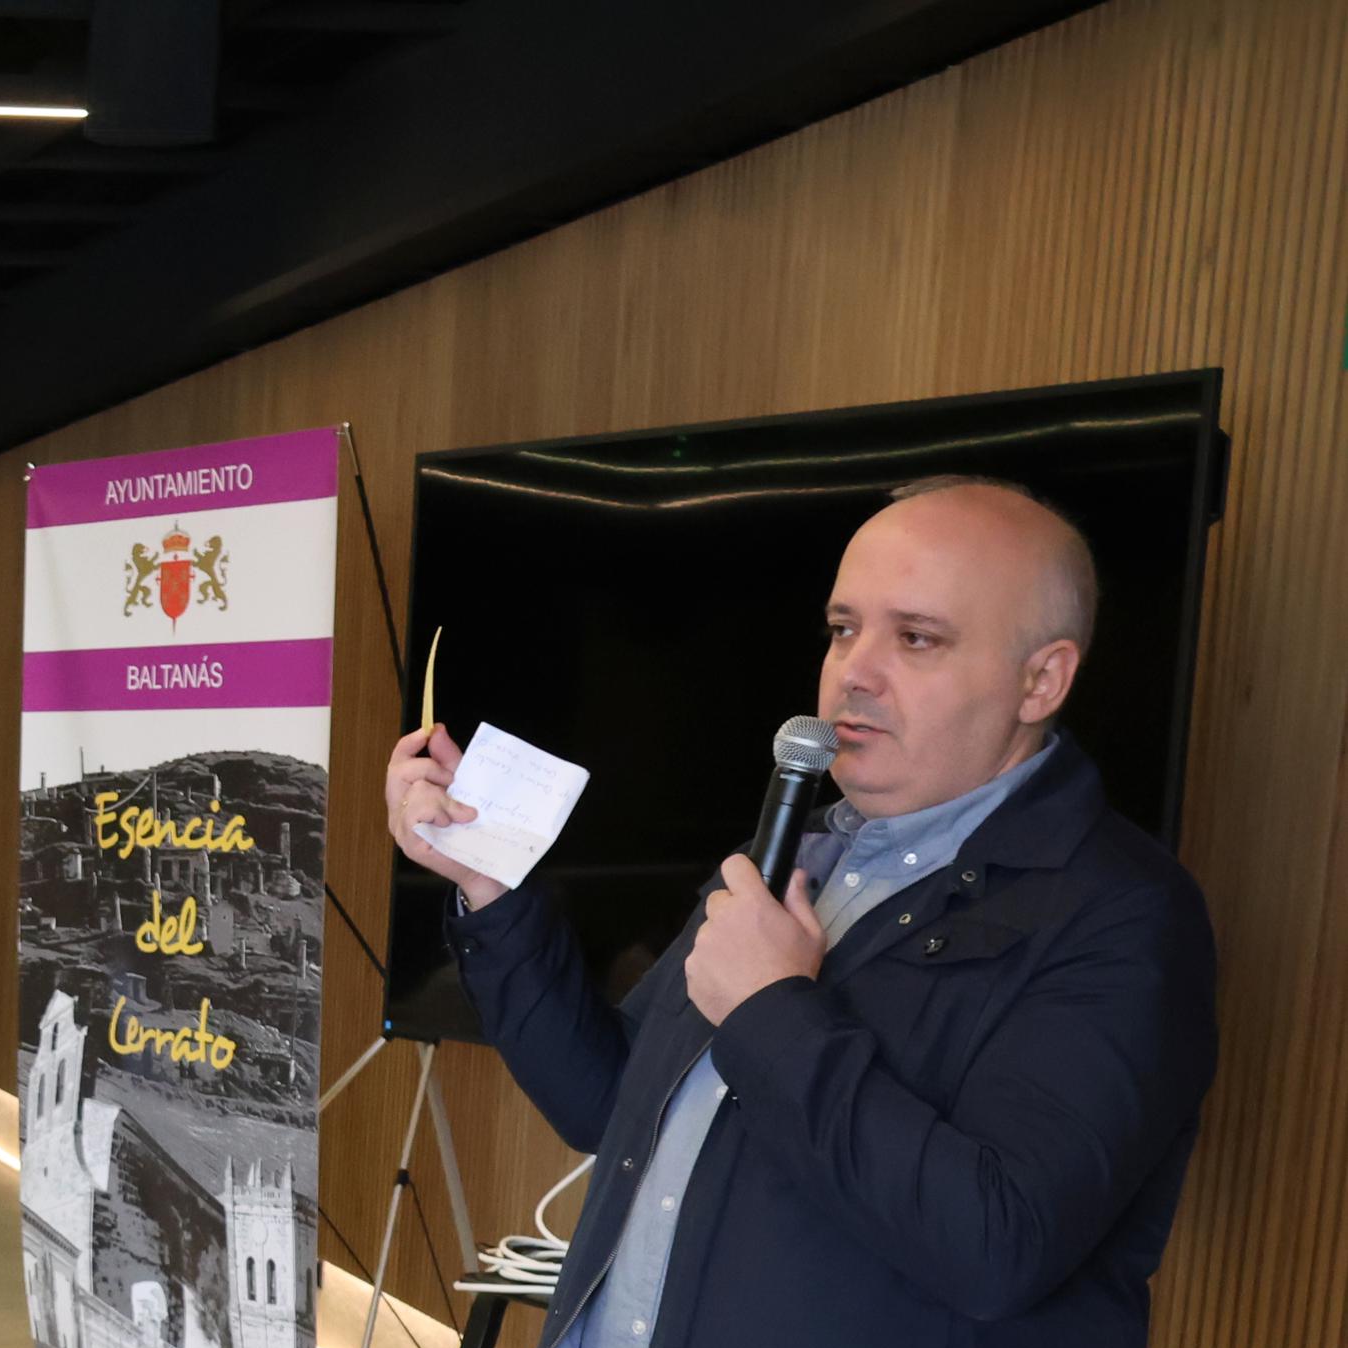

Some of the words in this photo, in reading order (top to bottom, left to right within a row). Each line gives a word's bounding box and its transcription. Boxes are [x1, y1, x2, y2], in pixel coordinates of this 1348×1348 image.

[105, 463, 254, 506] AYUNTAMIENTO
[126, 655, 224, 691] BALTANÁS
[94, 791, 254, 860] Esencia
[135, 889, 204, 955] del
